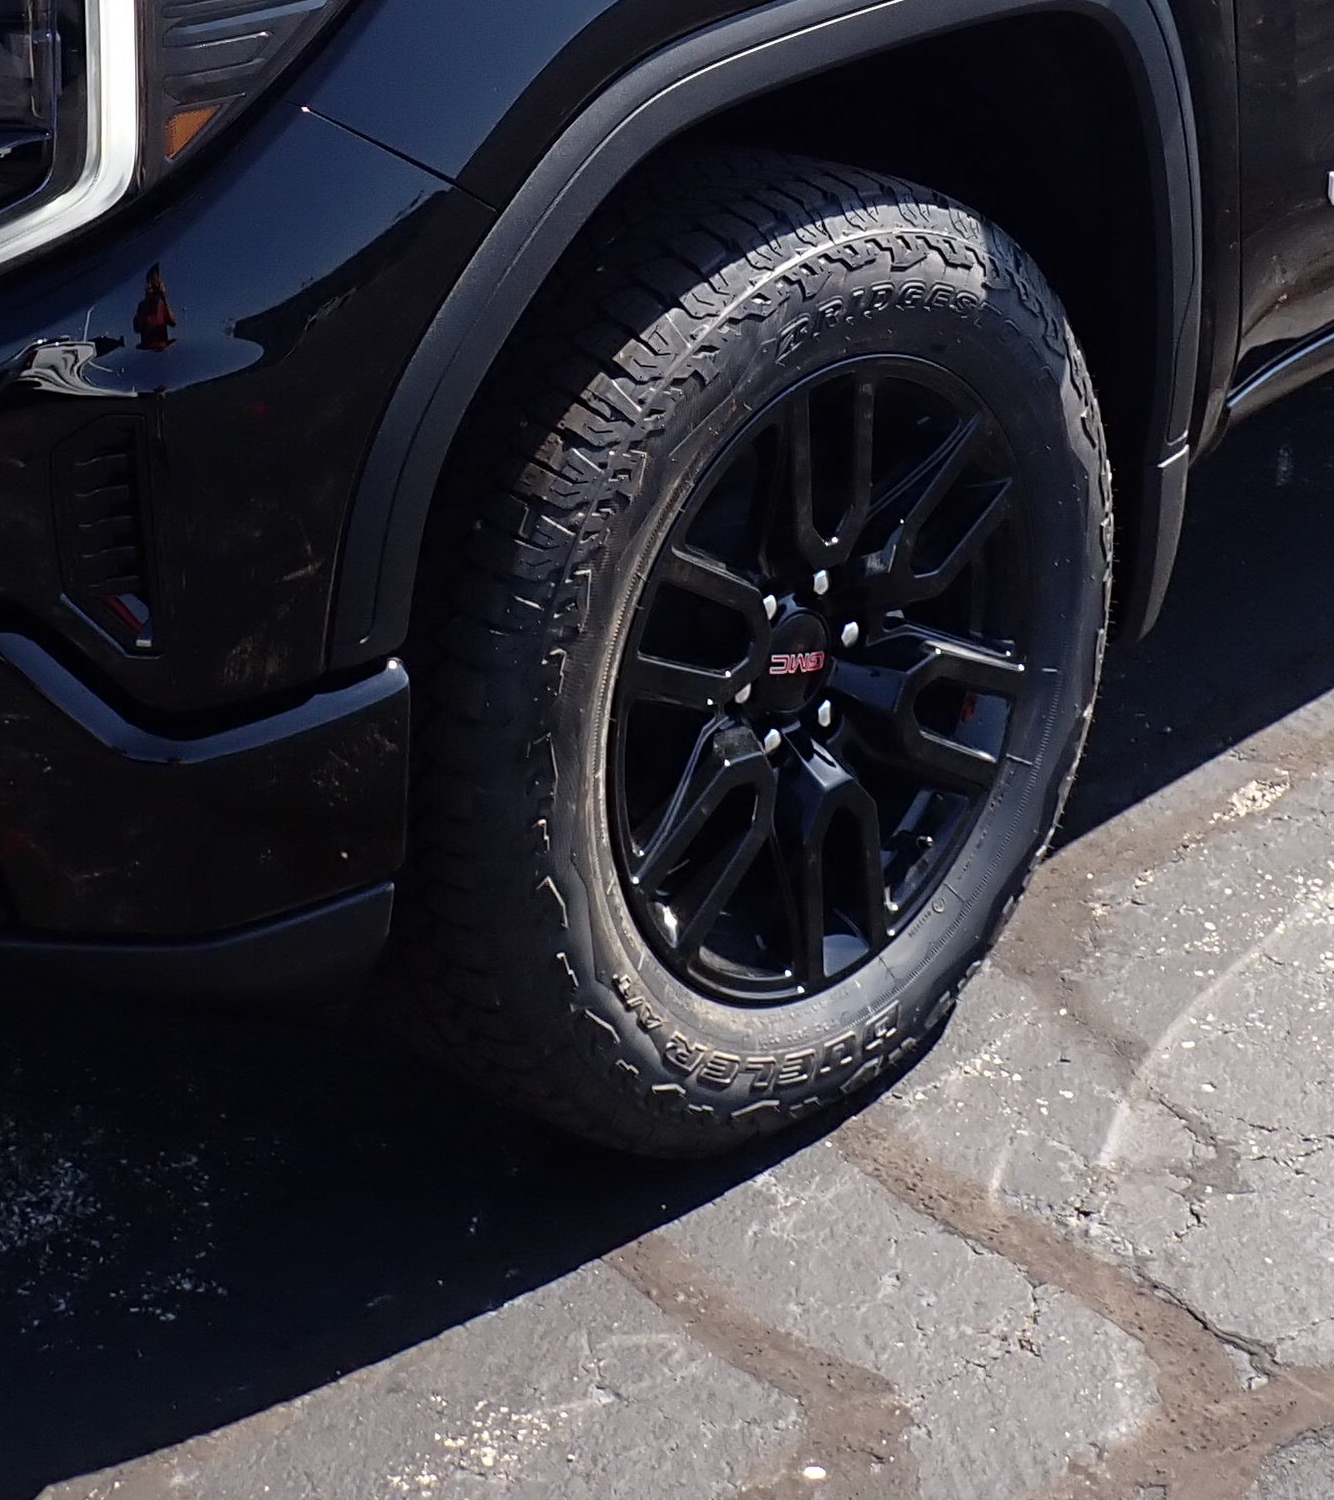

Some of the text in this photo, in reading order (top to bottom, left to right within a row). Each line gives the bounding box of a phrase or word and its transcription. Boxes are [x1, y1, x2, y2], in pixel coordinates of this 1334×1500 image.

[774, 279, 1060, 388] BRIDGESTO
[769, 651, 825, 675] GMC
[666, 999, 900, 1089] DUELER
